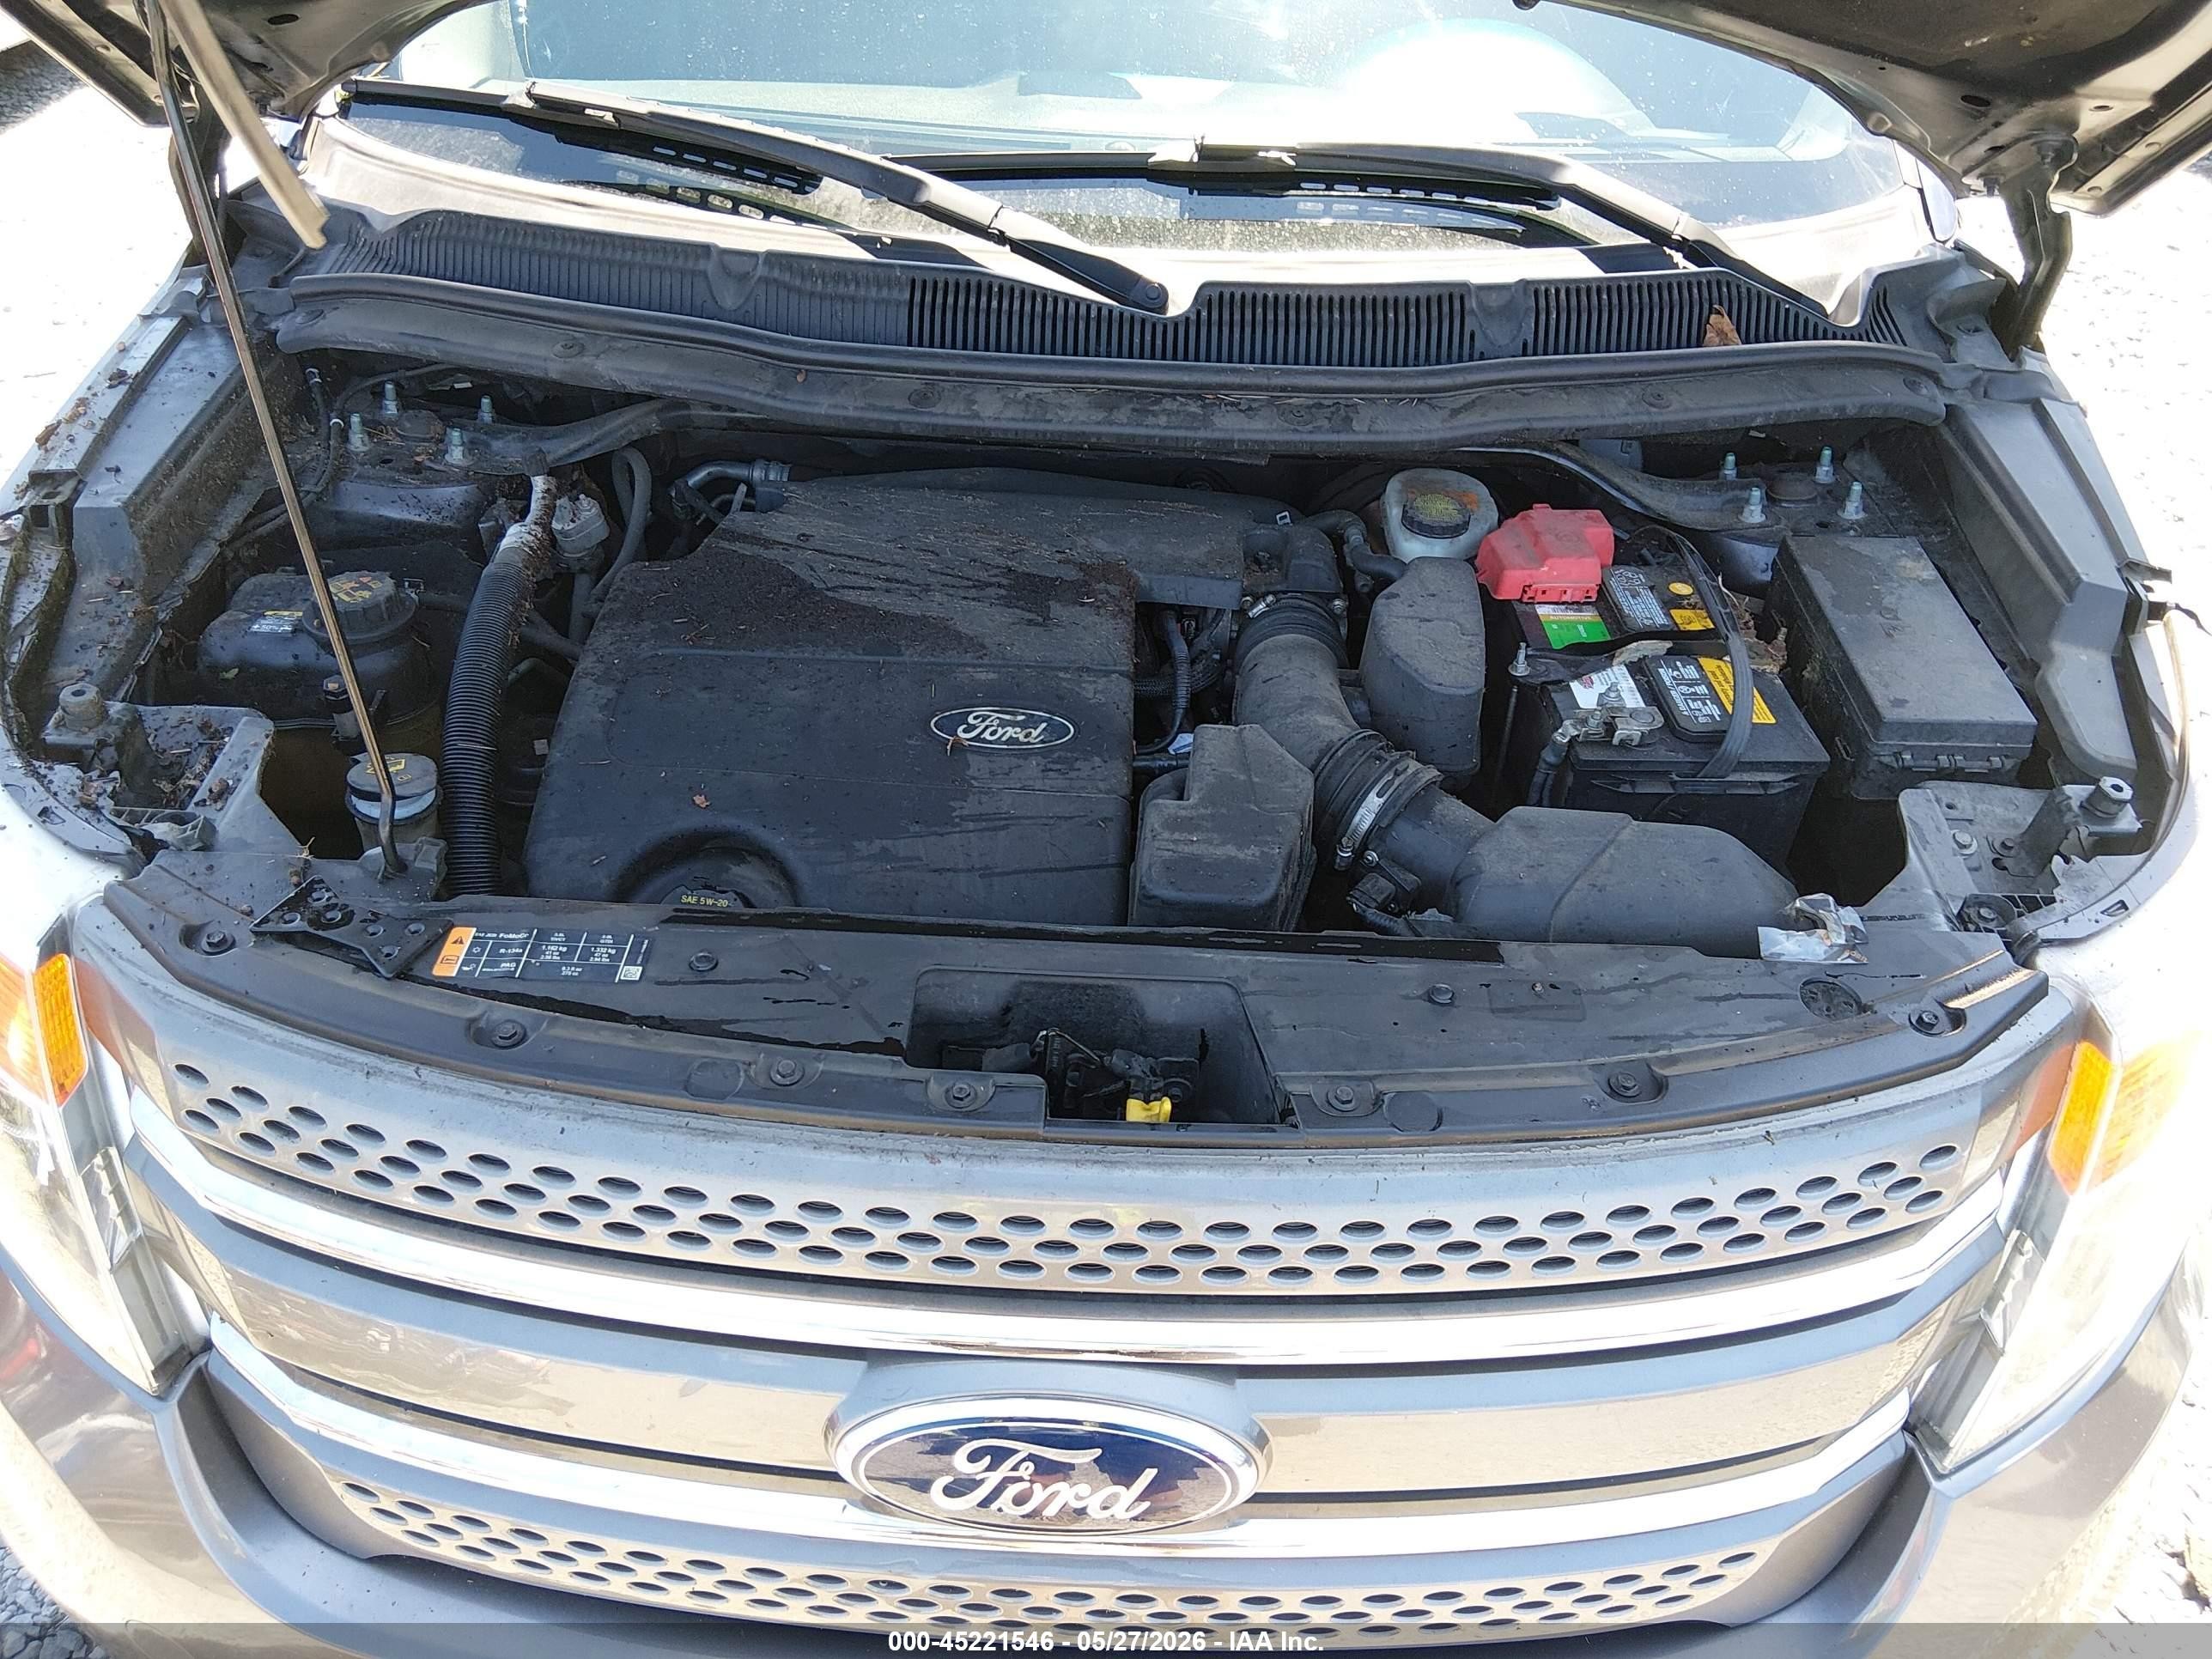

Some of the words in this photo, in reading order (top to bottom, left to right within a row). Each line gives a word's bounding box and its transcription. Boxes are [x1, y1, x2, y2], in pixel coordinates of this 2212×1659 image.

[957, 711, 1048, 744] Ford
[680, 895, 698, 905] SAE
[700, 896, 728, 908] 5W-20
[930, 1438, 1158, 1520] Ford
